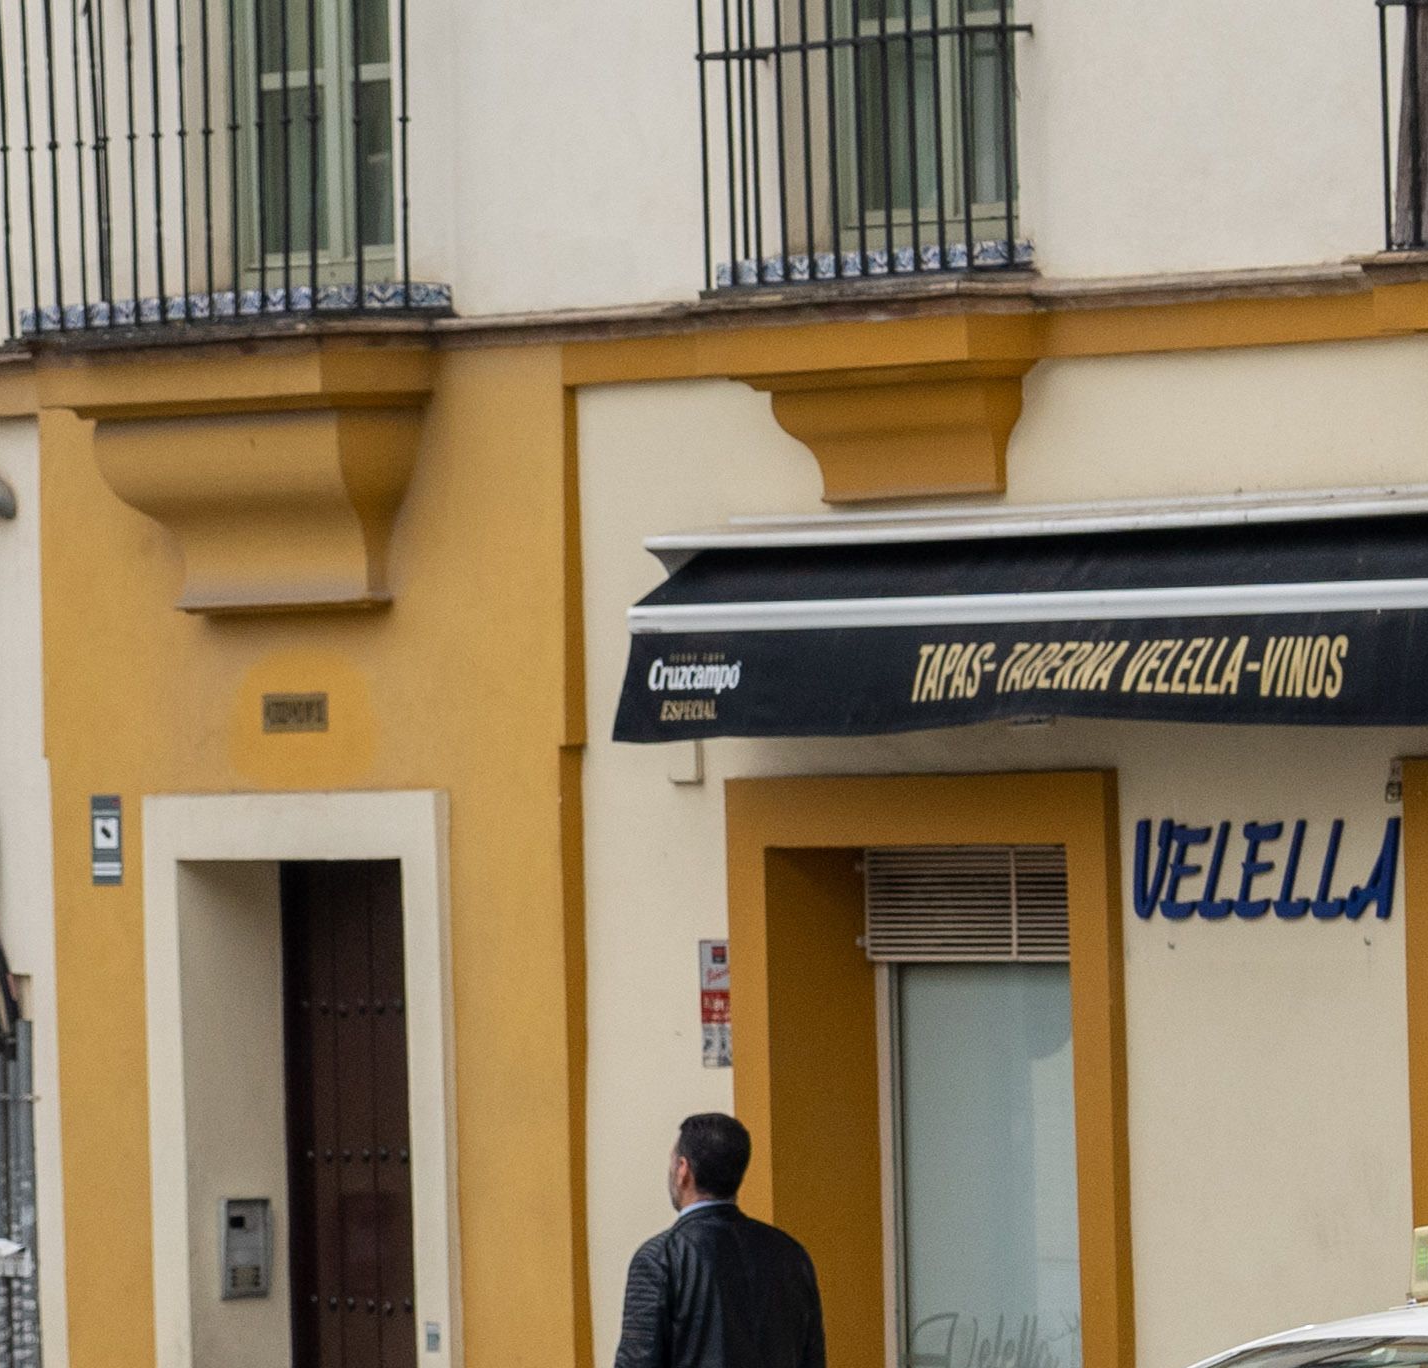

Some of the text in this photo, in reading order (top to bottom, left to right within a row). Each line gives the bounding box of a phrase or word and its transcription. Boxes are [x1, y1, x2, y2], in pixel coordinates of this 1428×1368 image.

[648, 657, 742, 695] Cruzcampo
[911, 633, 1348, 703] TAPAS- TABERNA VELELLA-VINOS
[659, 699, 718, 721] ESPECIAL
[1134, 818, 1401, 921] VELELLA
